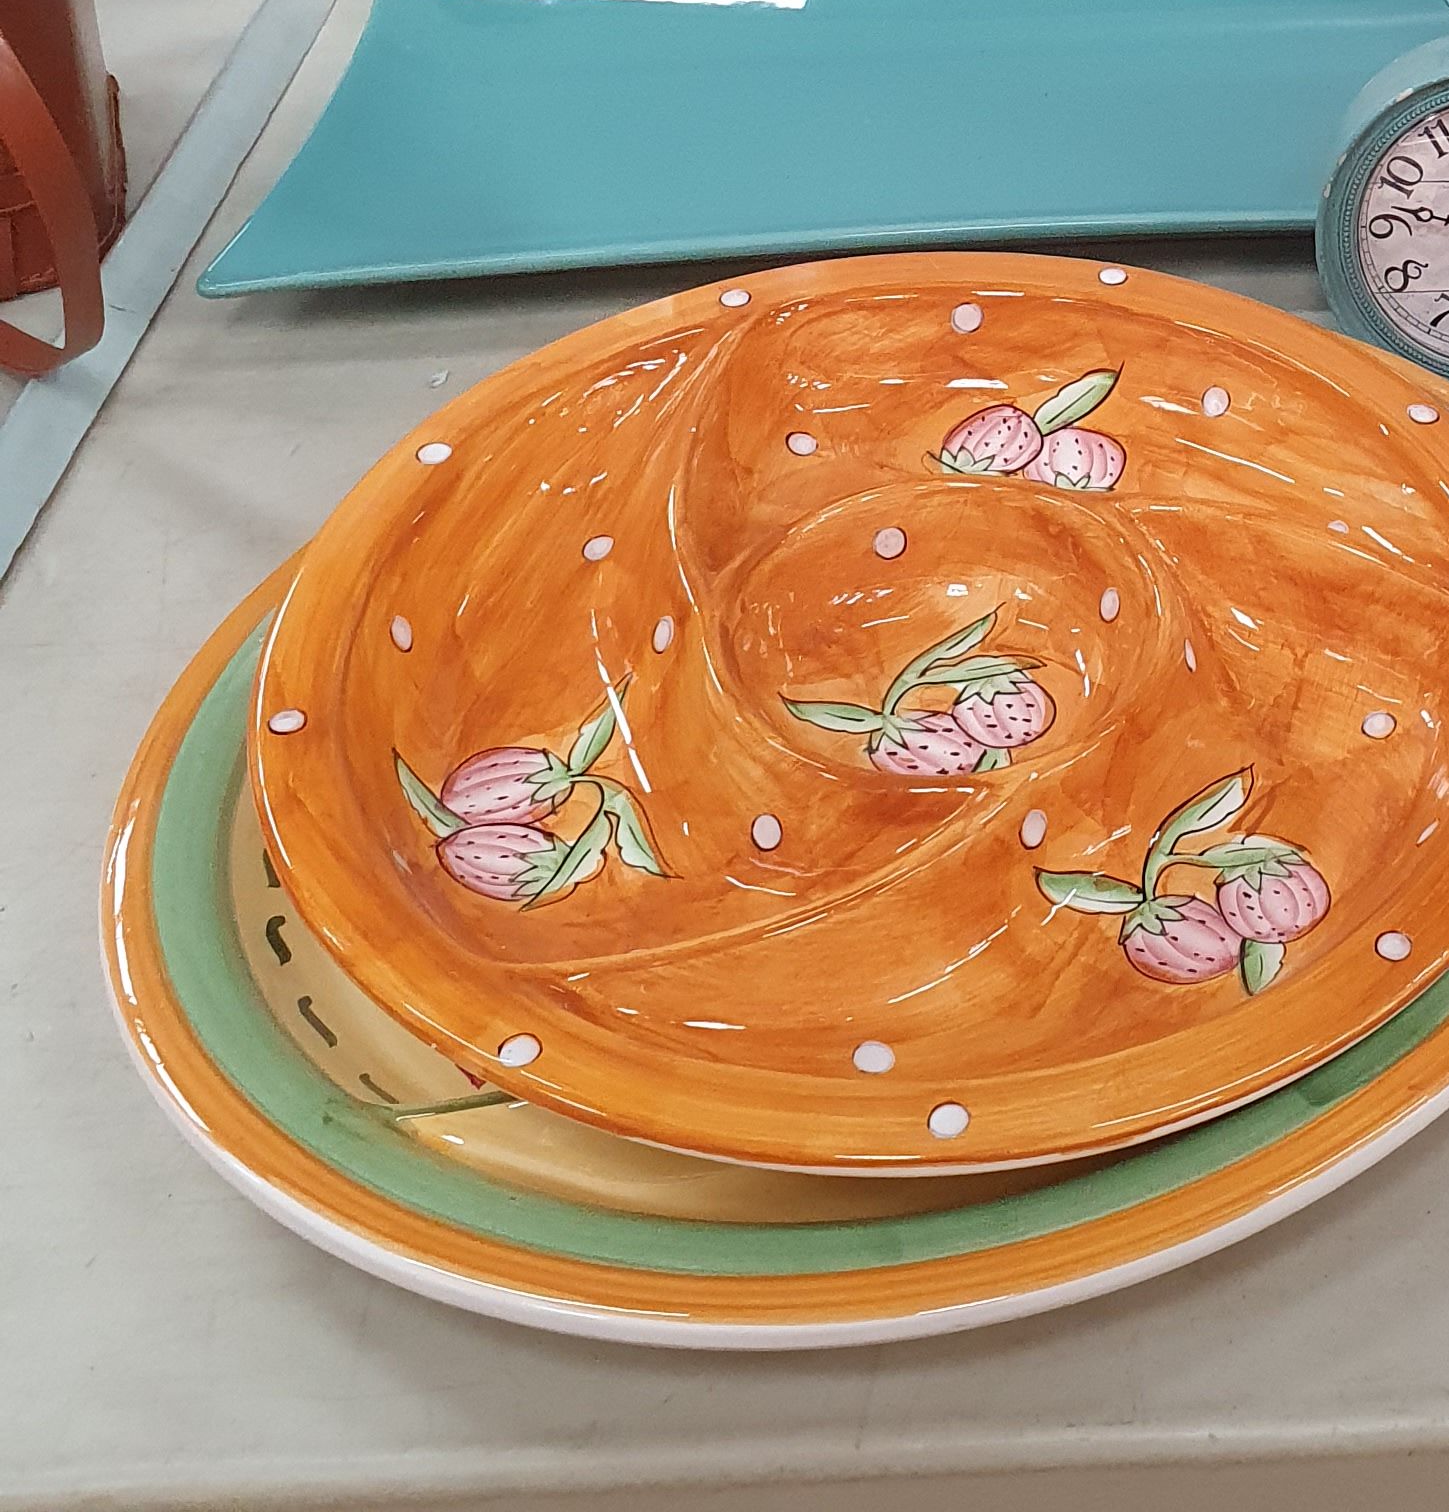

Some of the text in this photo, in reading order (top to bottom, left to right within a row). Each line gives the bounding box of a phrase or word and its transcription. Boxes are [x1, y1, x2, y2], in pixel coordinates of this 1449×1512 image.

[1377, 155, 1424, 200] 10
[1368, 213, 1413, 239] 9
[1384, 259, 1429, 293] 8
